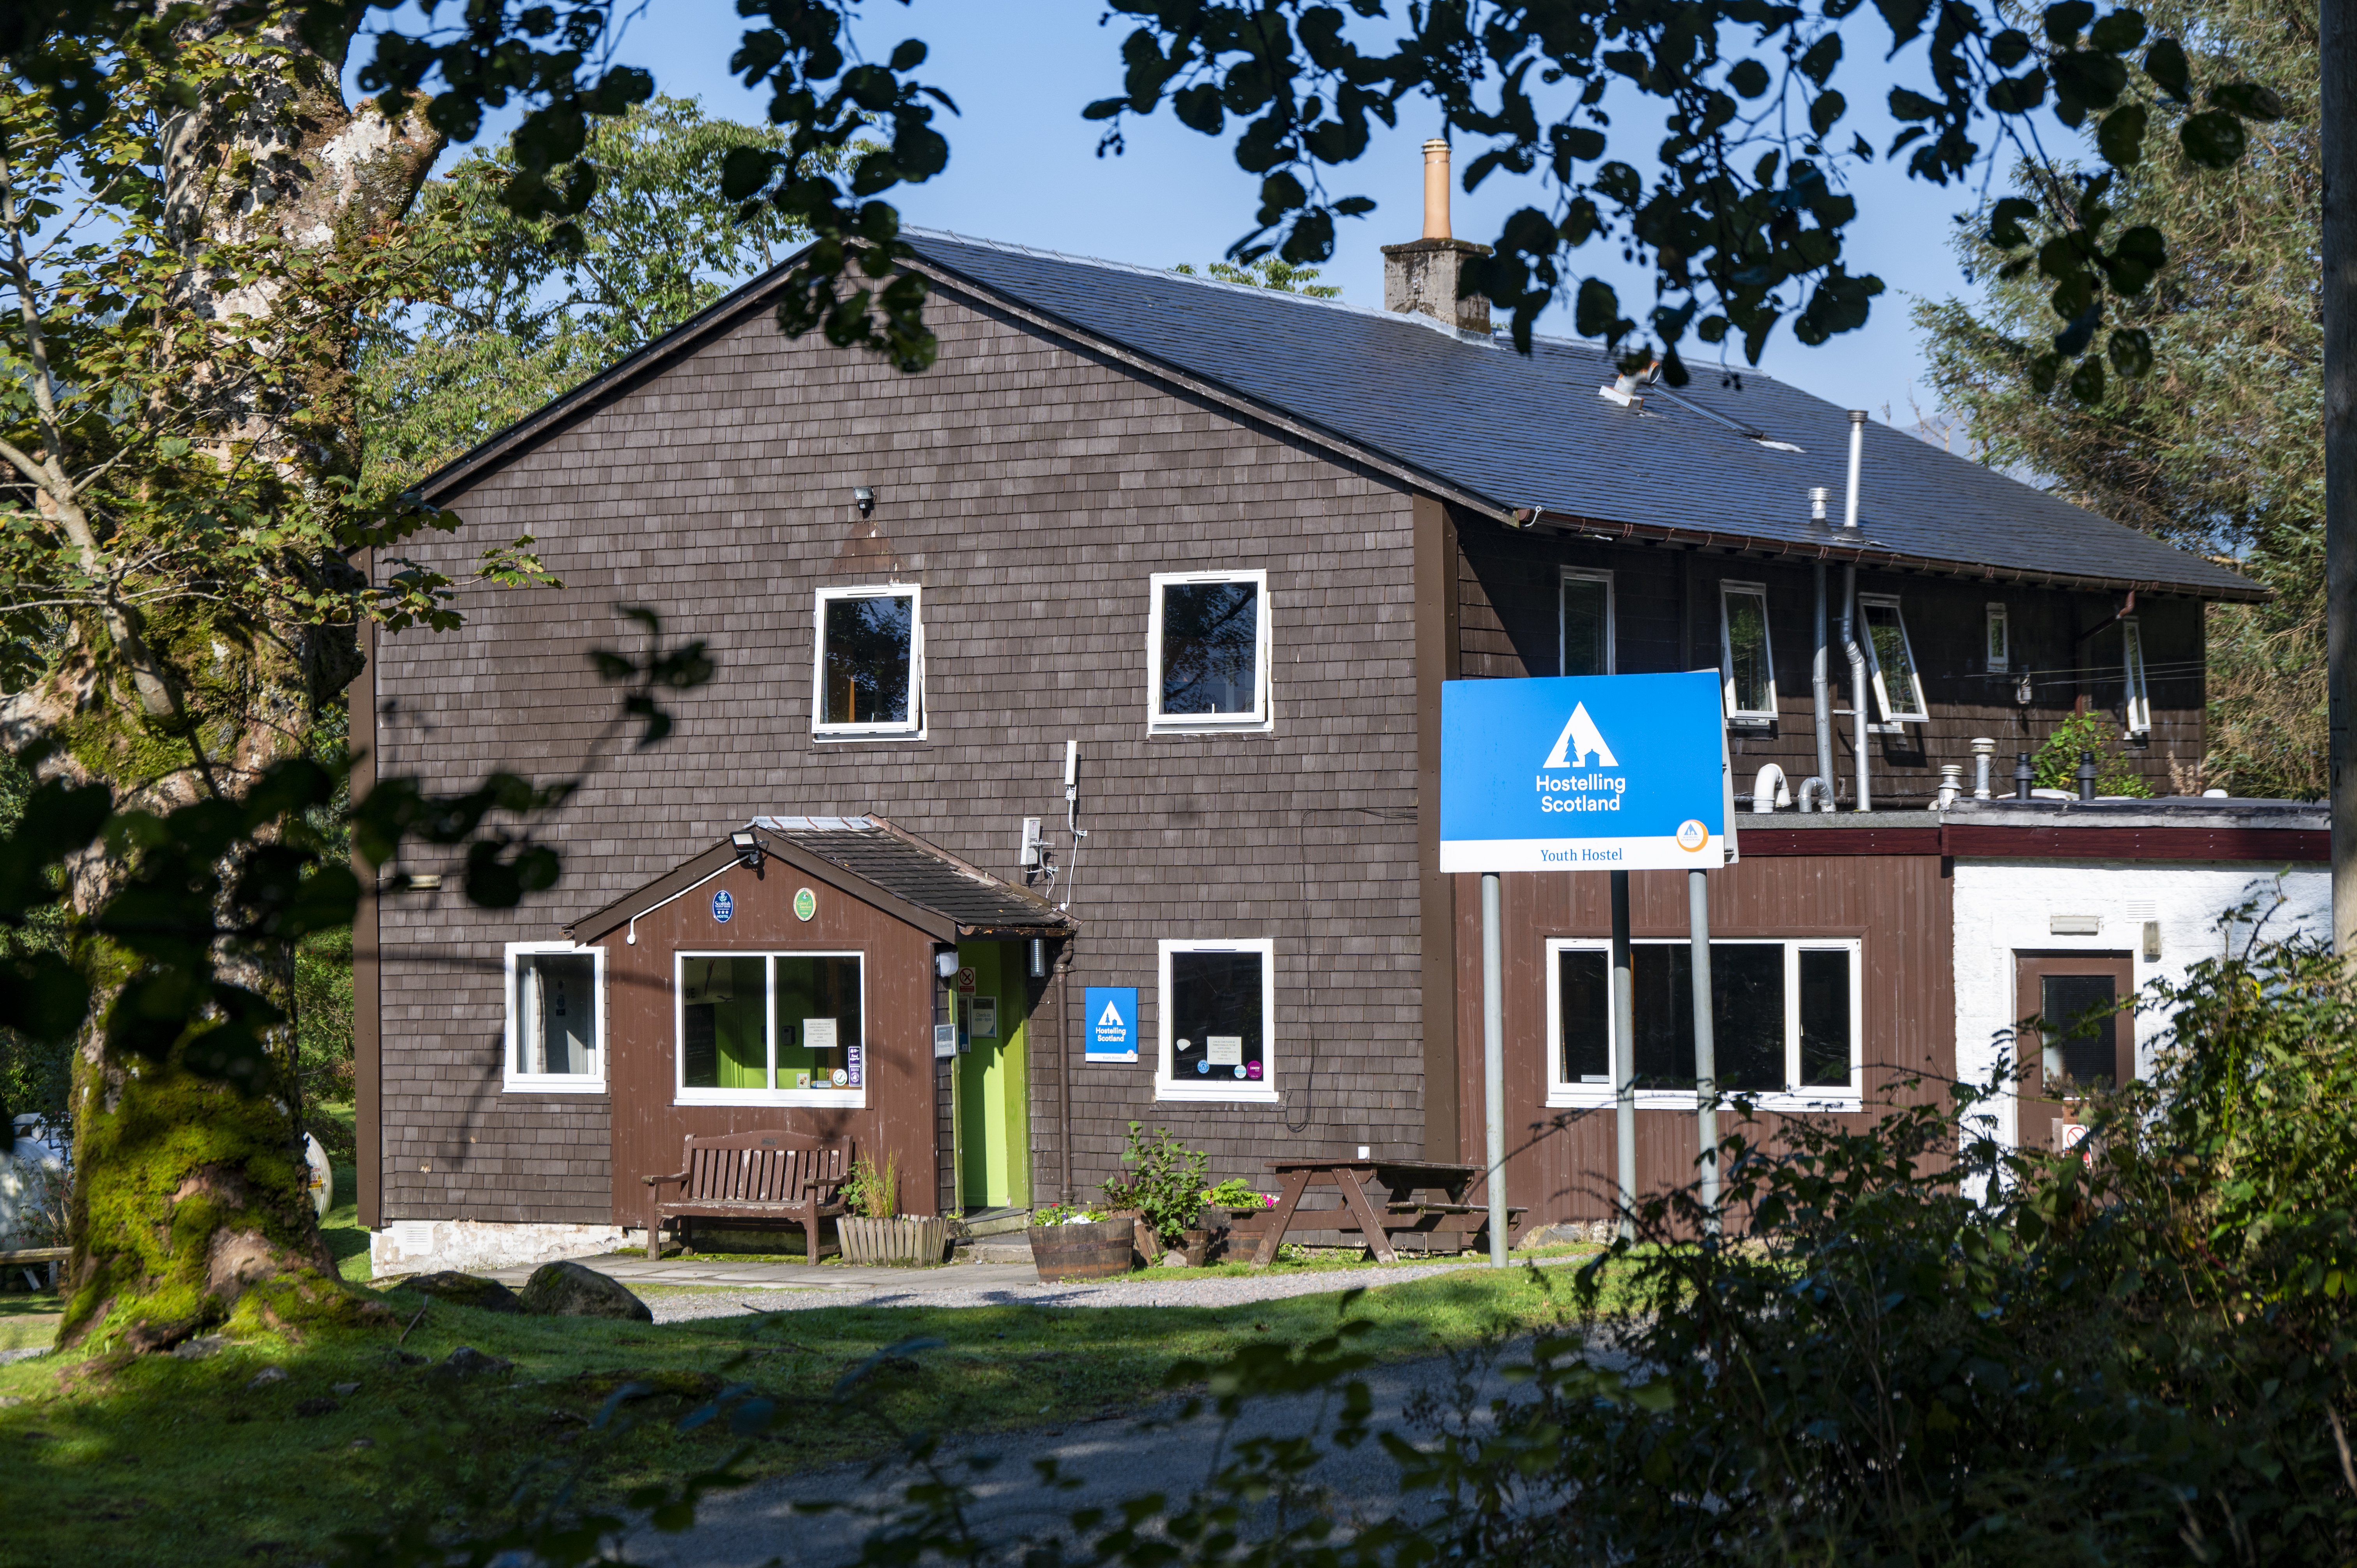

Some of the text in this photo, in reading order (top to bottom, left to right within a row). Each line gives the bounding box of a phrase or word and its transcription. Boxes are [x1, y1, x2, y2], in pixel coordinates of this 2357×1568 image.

[1536, 773, 1626, 794] Hostelling
[1541, 794, 1620, 812] Scotland
[1541, 848, 1622, 861] Youth Hostel
[1095, 1027, 1126, 1035] Hostelling
